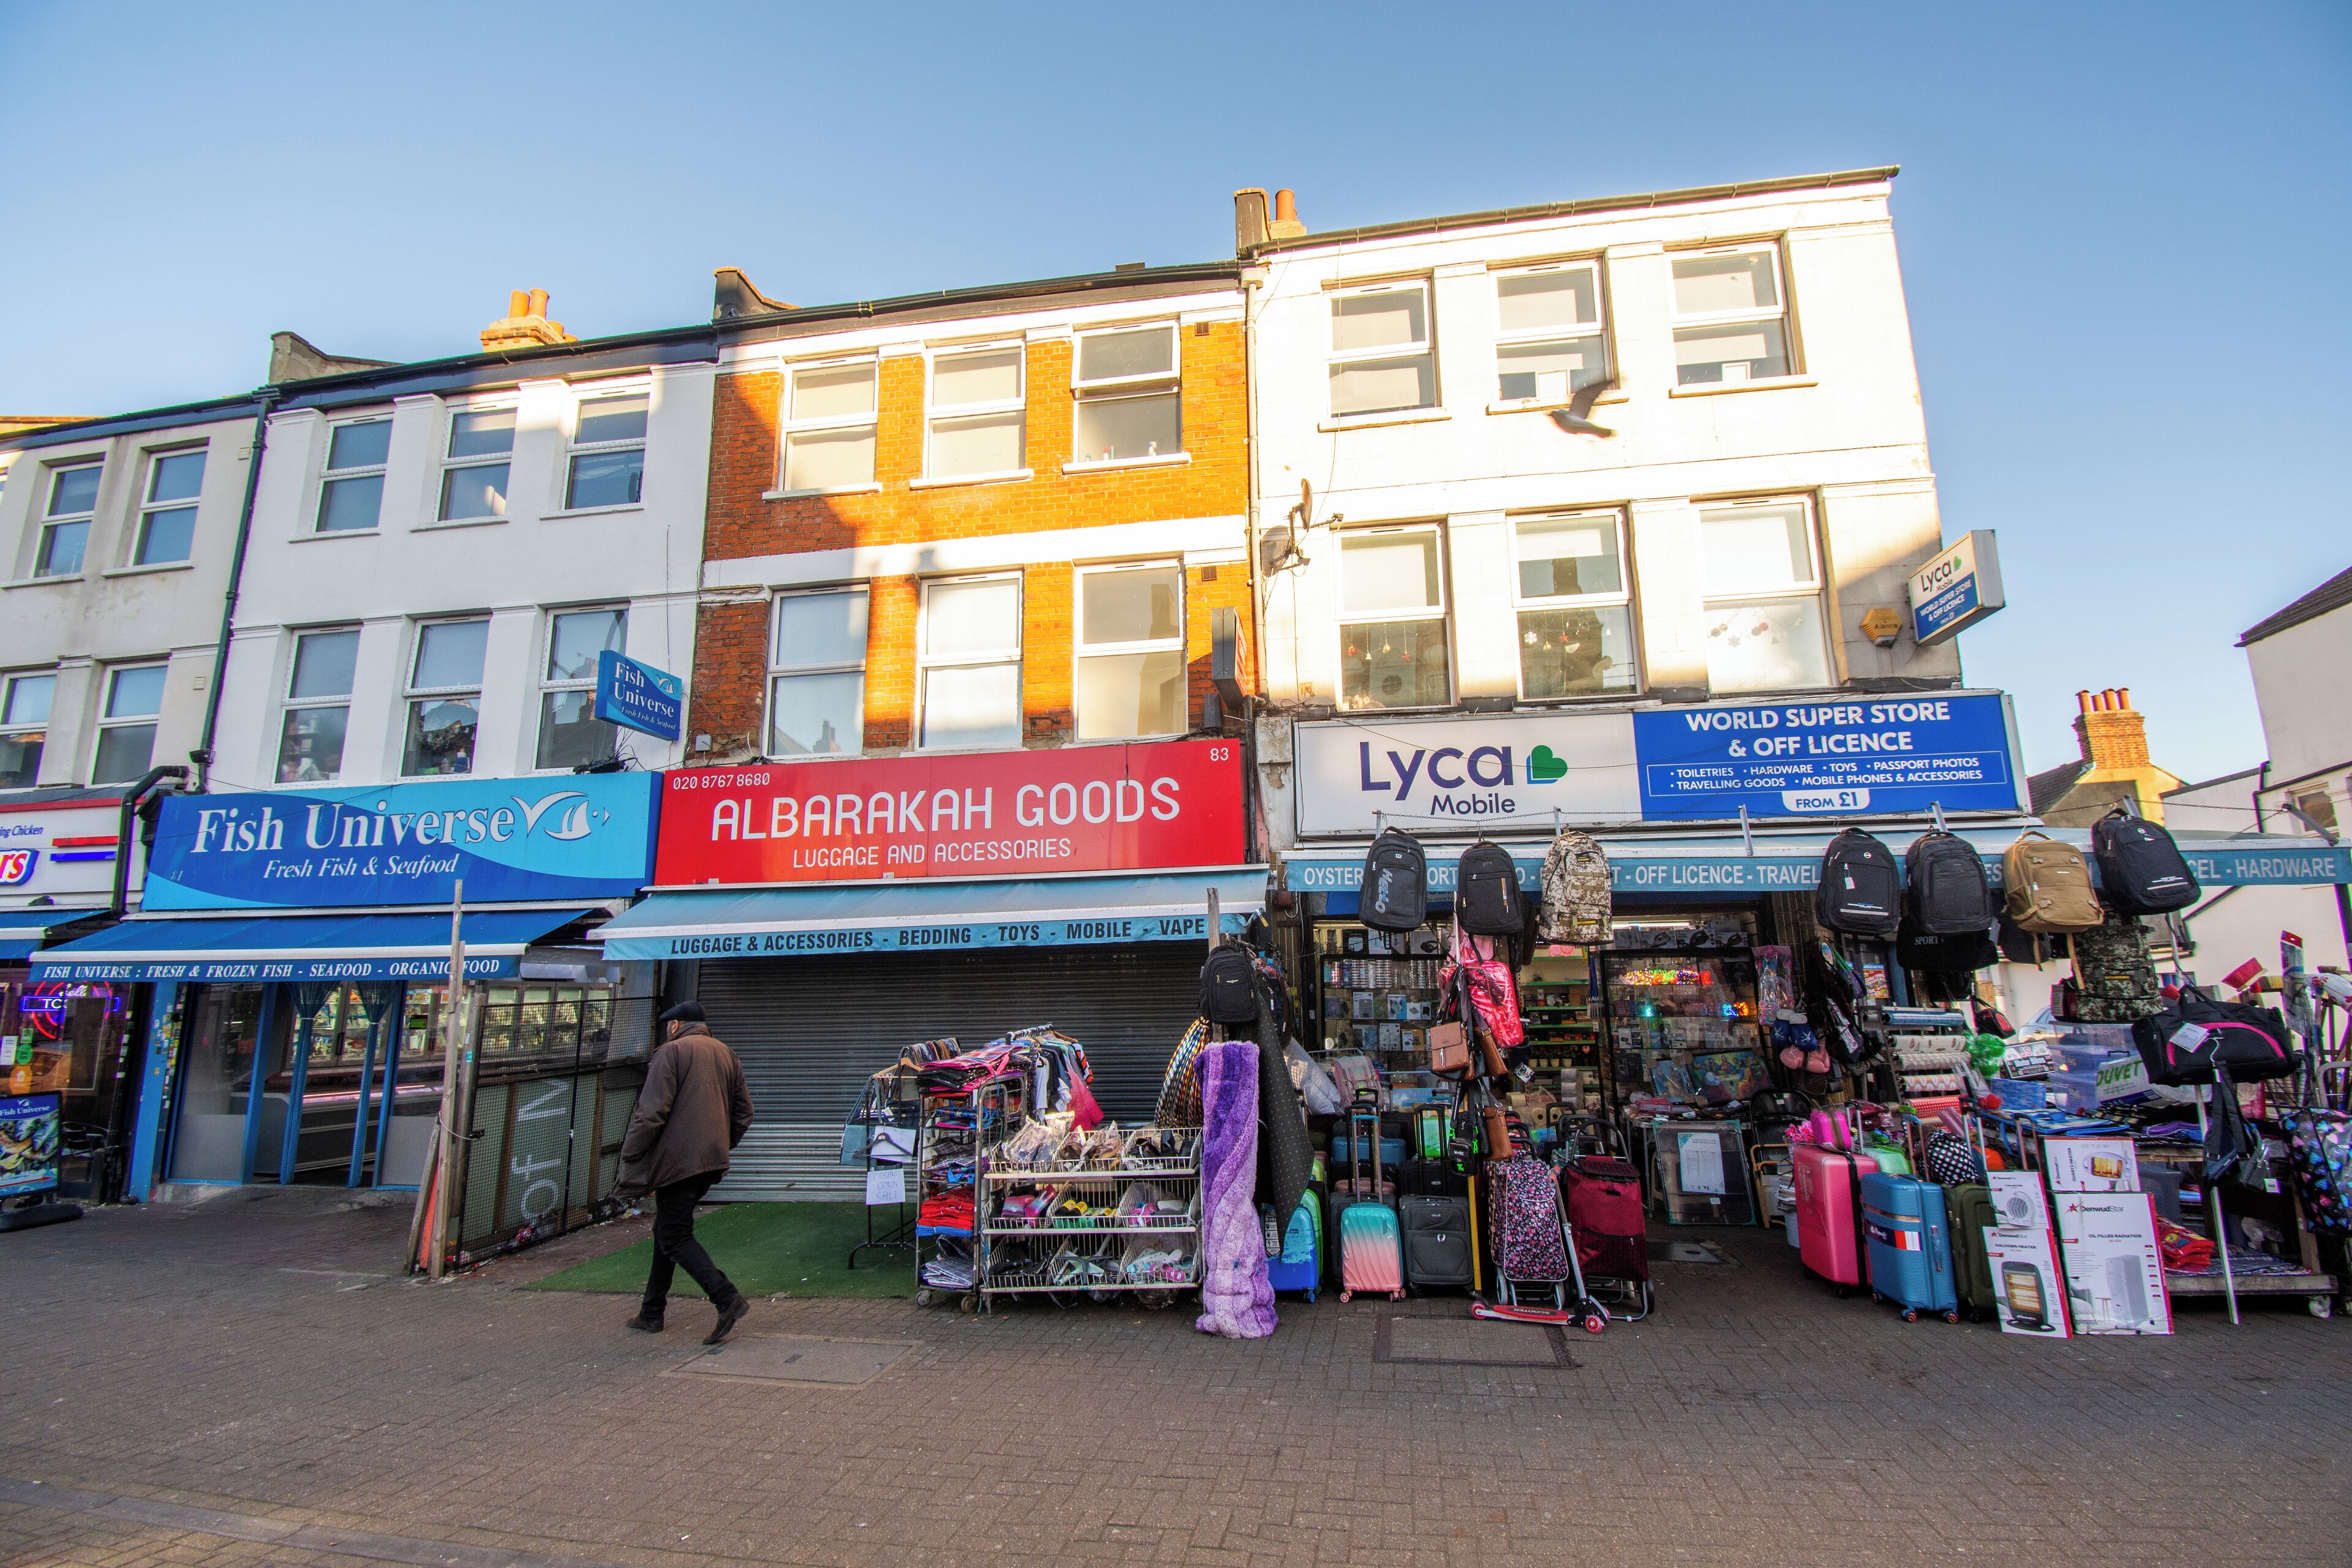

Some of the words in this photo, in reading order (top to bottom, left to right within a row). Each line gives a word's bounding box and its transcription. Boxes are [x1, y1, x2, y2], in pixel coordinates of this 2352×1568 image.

[1920, 560, 1952, 593] Lyca
[1936, 578, 1953, 593] Mobile
[1920, 600, 1939, 617] WORLD
[1939, 590, 1956, 606] SUPER
[1954, 579, 1972, 595] STORE
[1928, 613, 1934, 622] &
[1933, 606, 1943, 619] OFF
[1943, 594, 1966, 612] LICENCE
[614, 661, 644, 687] Fish
[614, 681, 674, 717] Universe
[621, 706, 637, 717] Fresh
[638, 712, 649, 722] Fish
[656, 717, 676, 729] Seafood
[1685, 710, 1779, 731] WORLD
[1785, 706, 1864, 727] SUPER
[1870, 701, 1951, 723] STORE
[1210, 747, 1229, 762] 83
[1728, 739, 1747, 758] &
[1753, 736, 1801, 756] OFF
[1807, 731, 1913, 755] LICENCE
[1360, 741, 1514, 801] Lyca
[1676, 767, 1734, 778] TOILETRIES
[1750, 764, 1814, 775] HARDWARE
[1829, 762, 1858, 772] TOYS
[1874, 759, 1930, 771] PASSPORT
[1932, 757, 1980, 768] PHOTOS
[673, 774, 698, 790] 020
[701, 774, 734, 789] 8767
[736, 772, 770, 788] 8680
[1676, 778, 1742, 790] TRAVELLING
[1744, 777, 1786, 788] GOODS
[1802, 773, 1845, 786] MOBILE
[1846, 772, 1893, 784] PHONES
[1896, 773, 1904, 783] &
[1907, 769, 1983, 782] ACCESSORIES
[711, 786, 993, 842] ALBARAKAH
[1016, 777, 1180, 827] GOODS
[1430, 793, 1516, 816] Mobile
[1795, 797, 1834, 809] FROM
[1839, 791, 1858, 807] £1
[12, 824, 43, 836] Chicken
[190, 806, 284, 853] Fish
[306, 799, 515, 850] Universe
[793, 846, 880, 869] LUGGAGE
[887, 843, 925, 864] AND
[935, 837, 1071, 864] ACCESSORIES
[263, 859, 314, 878] Fresh
[318, 857, 358, 877] Fish
[362, 856, 379, 876] &
[384, 853, 460, 880] Seafood
[1304, 867, 1365, 886] OYSTER
[1635, 865, 1668, 884] OFF
[1672, 865, 1744, 884] LICENCE
[1756, 865, 1822, 884] TRAVEL
[2235, 858, 2337, 878] HARDWARE
[671, 936, 742, 955] LUGGAGE
[747, 935, 759, 951] &
[764, 930, 873, 951] ACCESSORIES
[899, 927, 971, 946] BEDDING
[998, 924, 1040, 942] TOYS
[1066, 921, 1133, 940] MOBILE
[1159, 918, 1205, 935] VAPE
[42, 966, 70, 978] FISH
[74, 965, 132, 978] UNIVERSE
[145, 965, 186, 978] FRESH
[189, 965, 200, 978] &
[206, 965, 258, 978] FROZEN
[262, 964, 293, 978] FISH
[309, 963, 372, 977] SEAFOOD
[389, 960, 451, 976] ORGANIC
[462, 959, 500, 974] FOOD
[17, 1105, 50, 1114] Universe
[875, 1190, 897, 1203] SALE
[877, 1181, 898, 1191] DOWN
